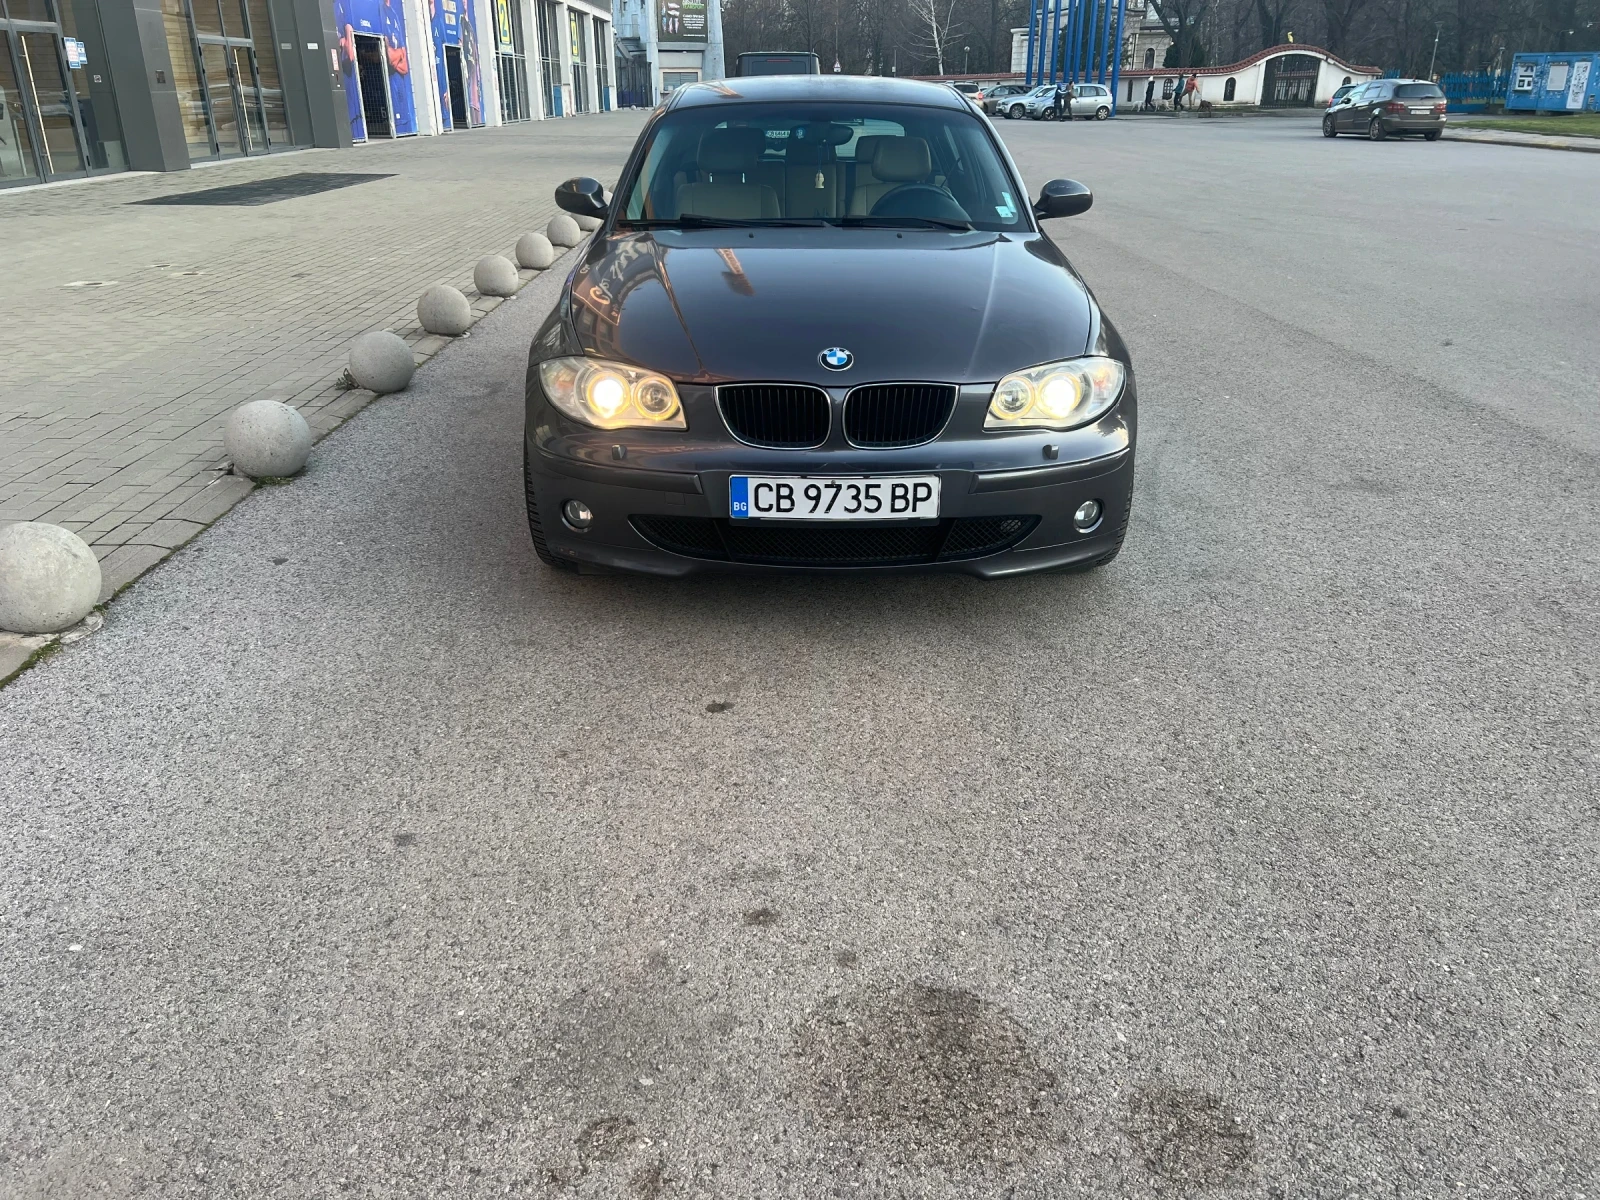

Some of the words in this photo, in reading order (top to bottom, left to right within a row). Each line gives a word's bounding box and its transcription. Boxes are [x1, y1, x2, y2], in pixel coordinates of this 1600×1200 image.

[500, 3, 508, 37] 2
[733, 502, 747, 511] BG
[754, 483, 795, 512] CB
[803, 483, 882, 513] 9735
[890, 483, 932, 512] BP
